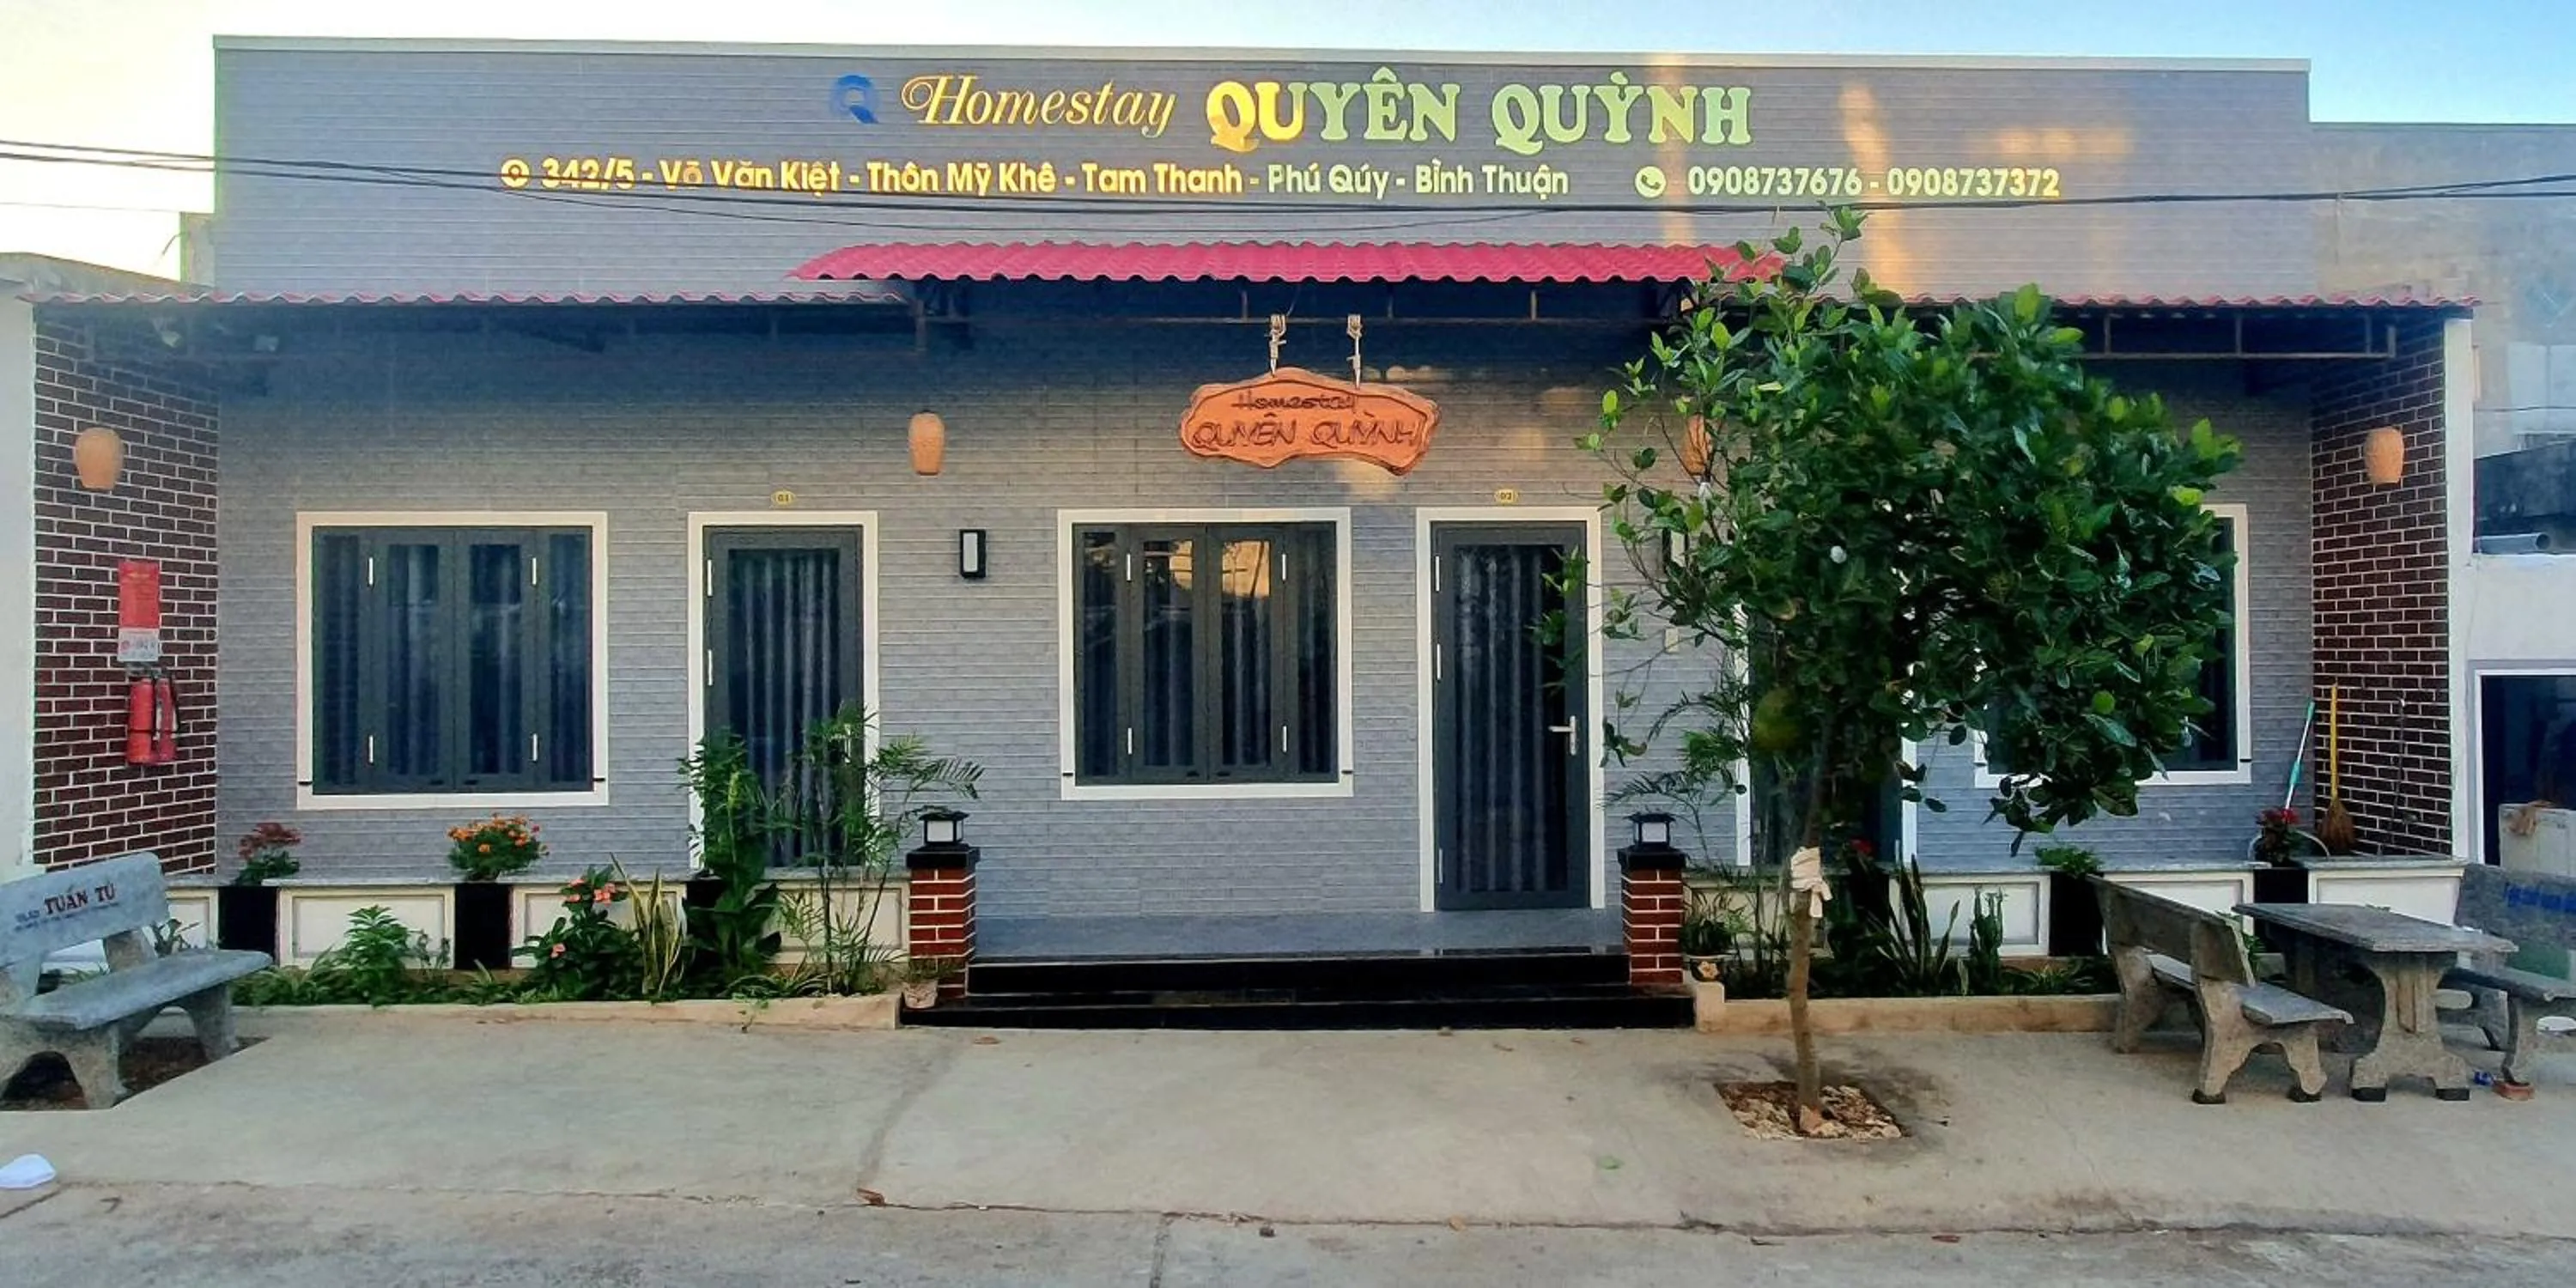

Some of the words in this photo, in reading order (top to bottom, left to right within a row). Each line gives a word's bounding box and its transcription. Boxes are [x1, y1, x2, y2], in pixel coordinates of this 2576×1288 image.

[901, 72, 1177, 138] Homestay
[1205, 66, 1461, 152] QUYÊN
[1491, 70, 1752, 155] QUỲNH
[541, 157, 635, 191] 342/5
[659, 160, 703, 191] Võ
[711, 161, 774, 190] Văn
[780, 160, 842, 197] Kiệt
[866, 161, 939, 192] Thôn
[947, 161, 993, 197] Mỹ
[999, 161, 1057, 192] Khê
[1081, 162, 1147, 193] Tam
[1154, 162, 1243, 194] Thanh
[1267, 162, 1321, 193] Phú
[1328, 163, 1390, 200] Qúy
[1482, 164, 1570, 200] Thuận
[1686, 167, 1864, 197] 0908737676
[1888, 166, 2061, 197] 0908737372
[1191, 412, 1297, 452] QUYÊN
[1310, 409, 1417, 449] QUỲNH
